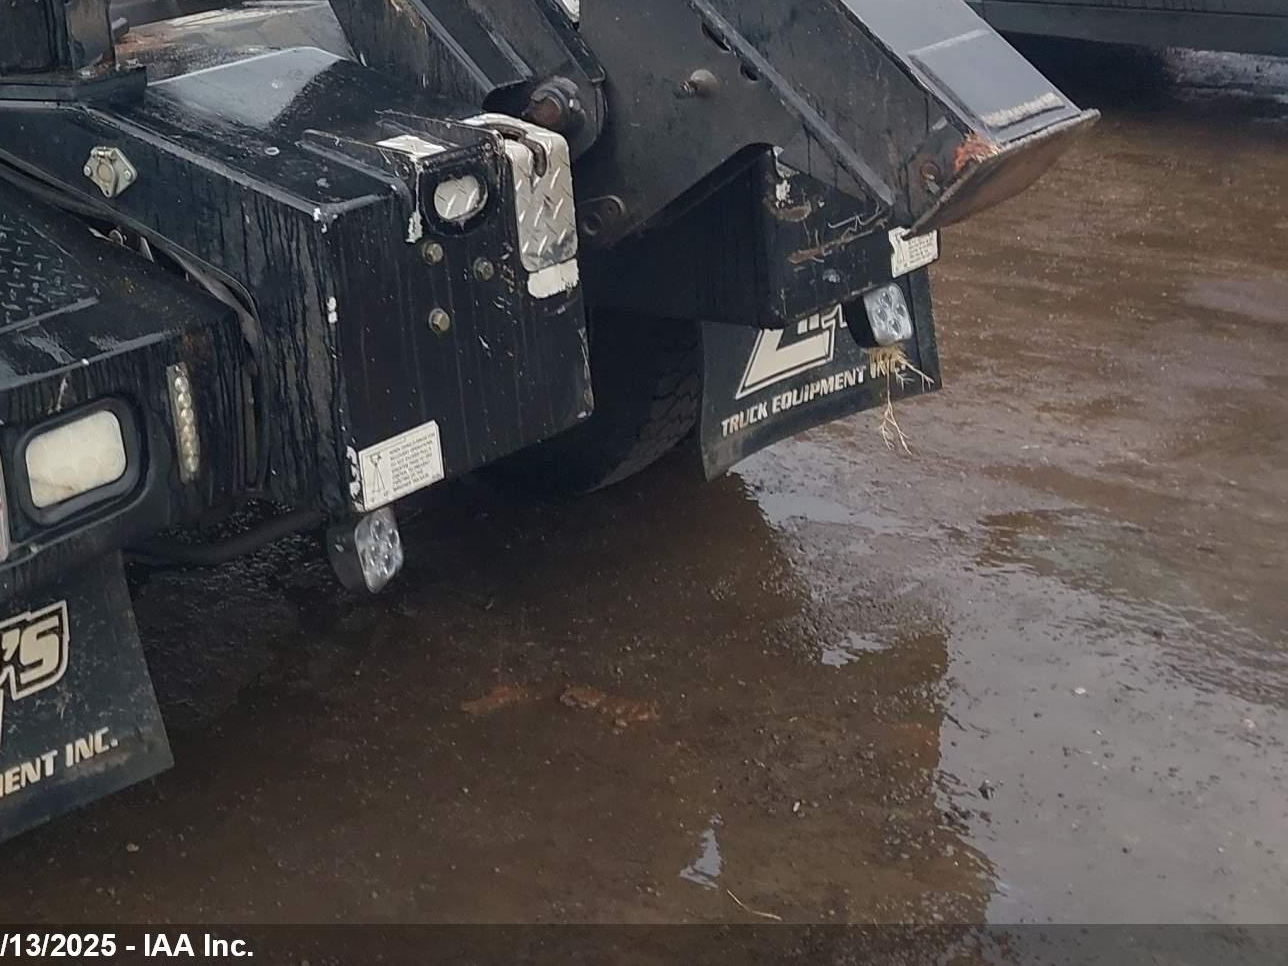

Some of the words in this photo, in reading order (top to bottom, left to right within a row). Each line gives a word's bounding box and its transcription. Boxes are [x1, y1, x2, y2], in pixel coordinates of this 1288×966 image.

[721, 400, 768, 437] TRUCK
[772, 365, 867, 414] EQUIPMENT
[65, 726, 118, 768] INC.
